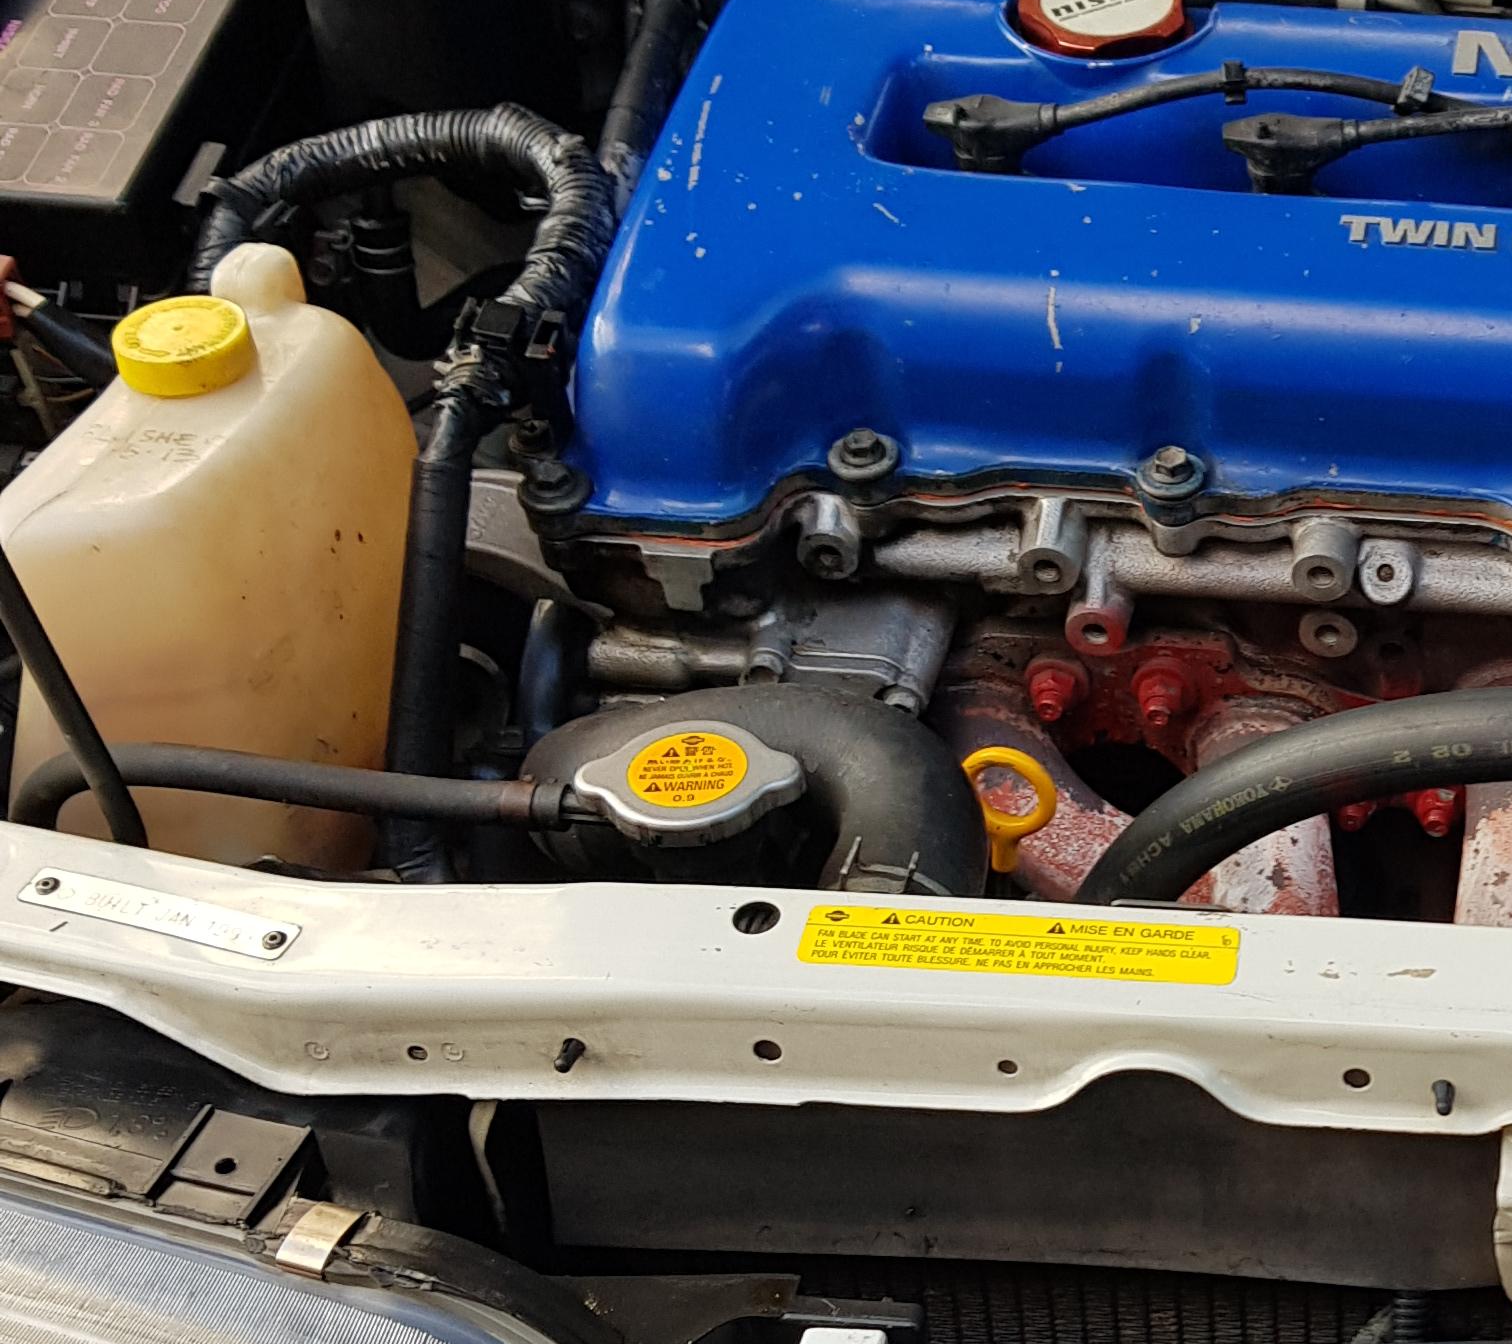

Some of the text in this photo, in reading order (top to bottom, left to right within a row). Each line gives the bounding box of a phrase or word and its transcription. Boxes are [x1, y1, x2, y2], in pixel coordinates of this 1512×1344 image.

[1339, 216, 1498, 251] TWIN
[664, 779, 725, 791] WARNING
[905, 914, 975, 927] CAUTION
[1070, 924, 1195, 941] MISE EN GARDE
[814, 940, 826, 948] LE
[833, 941, 897, 951] VENTILATEUR
[903, 944, 938, 954] RISQUE
[943, 946, 956, 954] DE
[1031, 950, 1054, 960] TOUT
[818, 929, 834, 937] FAN
[838, 931, 867, 939] BLADE
[893, 933, 921, 942] START
[939, 935, 959, 944] ANY
[1035, 941, 1079, 952] PERSONAL
[1120, 947, 1143, 956] KEEP
[1146, 948, 1176, 958] HANDS
[882, 953, 913, 963] TOUTE
[976, 958, 989, 967] NE
[993, 960, 1012, 968] PAS
[1016, 960, 1029, 969] EN
[1034, 961, 1092, 974] APPROCHER
[1096, 965, 1115, 974] LES
